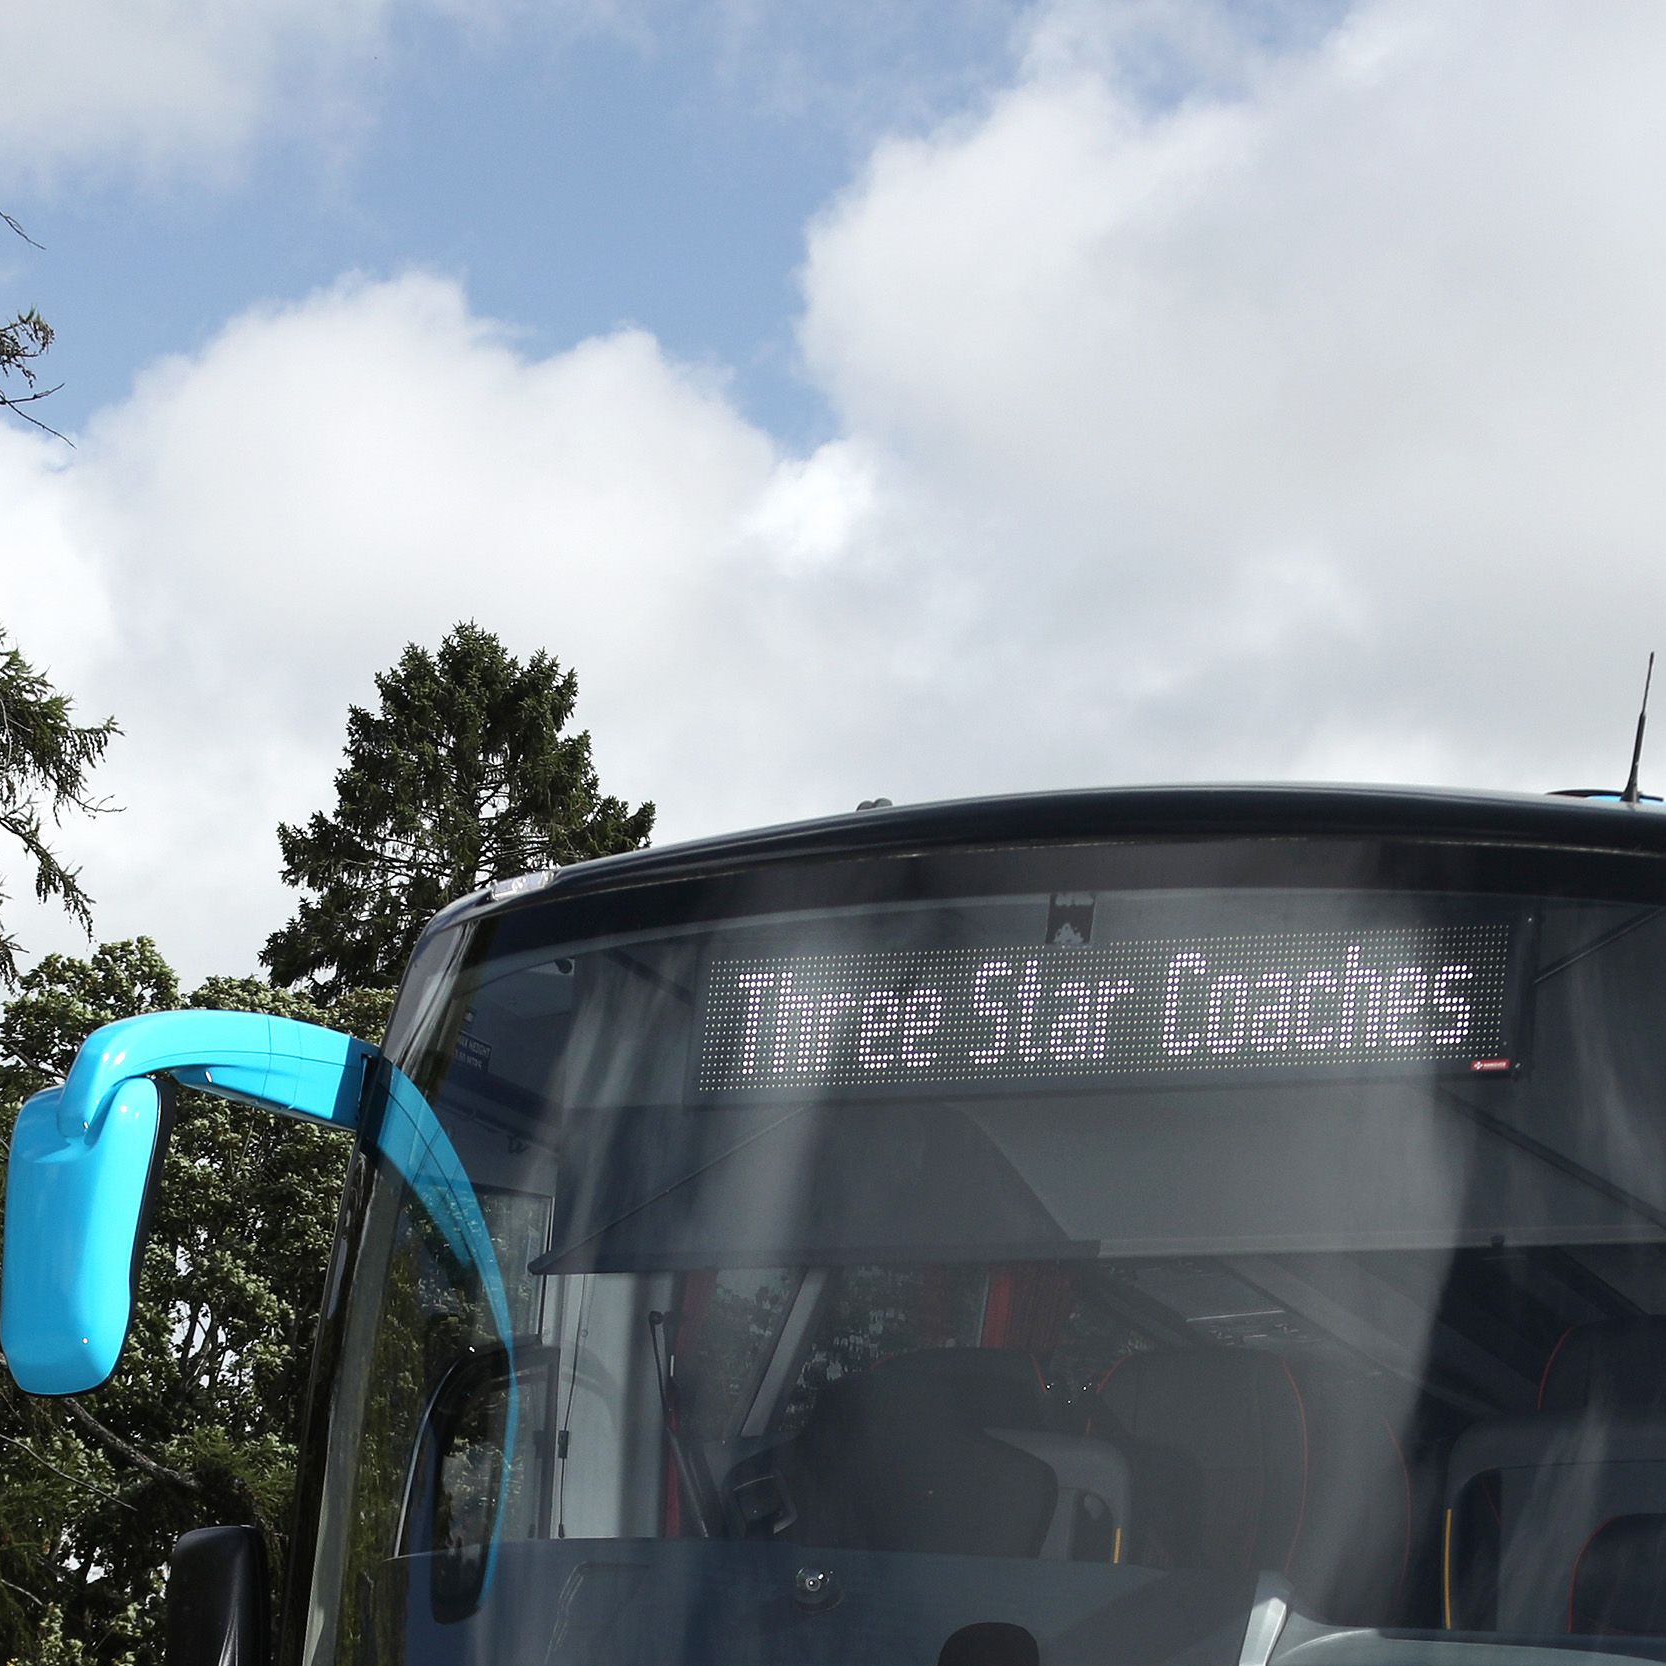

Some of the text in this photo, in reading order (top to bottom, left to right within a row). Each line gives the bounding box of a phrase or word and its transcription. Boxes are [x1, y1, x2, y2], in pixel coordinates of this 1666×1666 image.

[737, 945, 1475, 1077] Three Star Coaches
